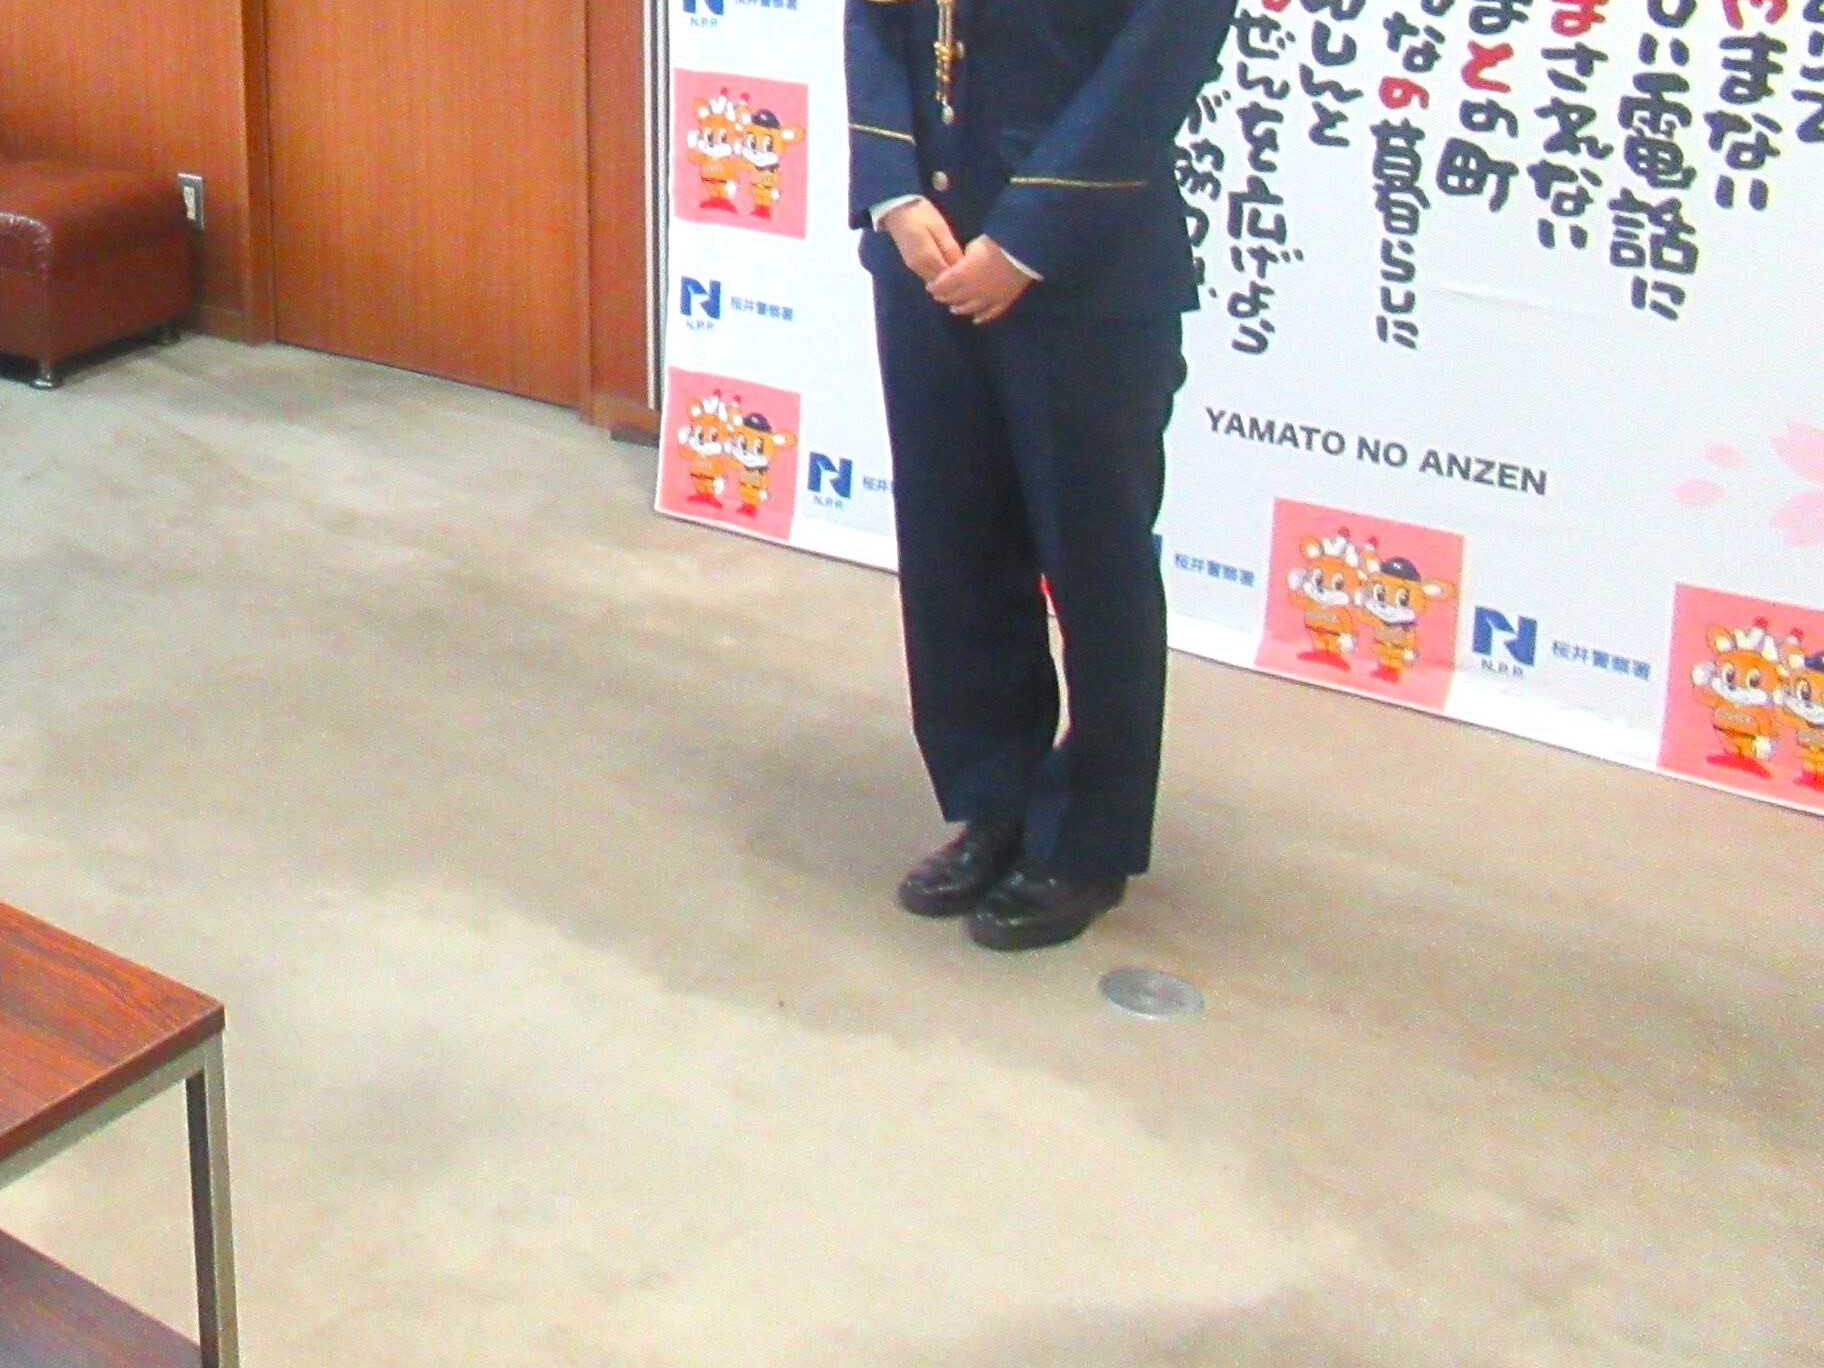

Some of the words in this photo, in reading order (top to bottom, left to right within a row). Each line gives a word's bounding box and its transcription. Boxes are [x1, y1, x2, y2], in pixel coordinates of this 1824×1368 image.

[1205, 406, 1346, 456] YAMATO
[1356, 435, 1408, 468] NO
[1418, 449, 1548, 496] ANZEN
